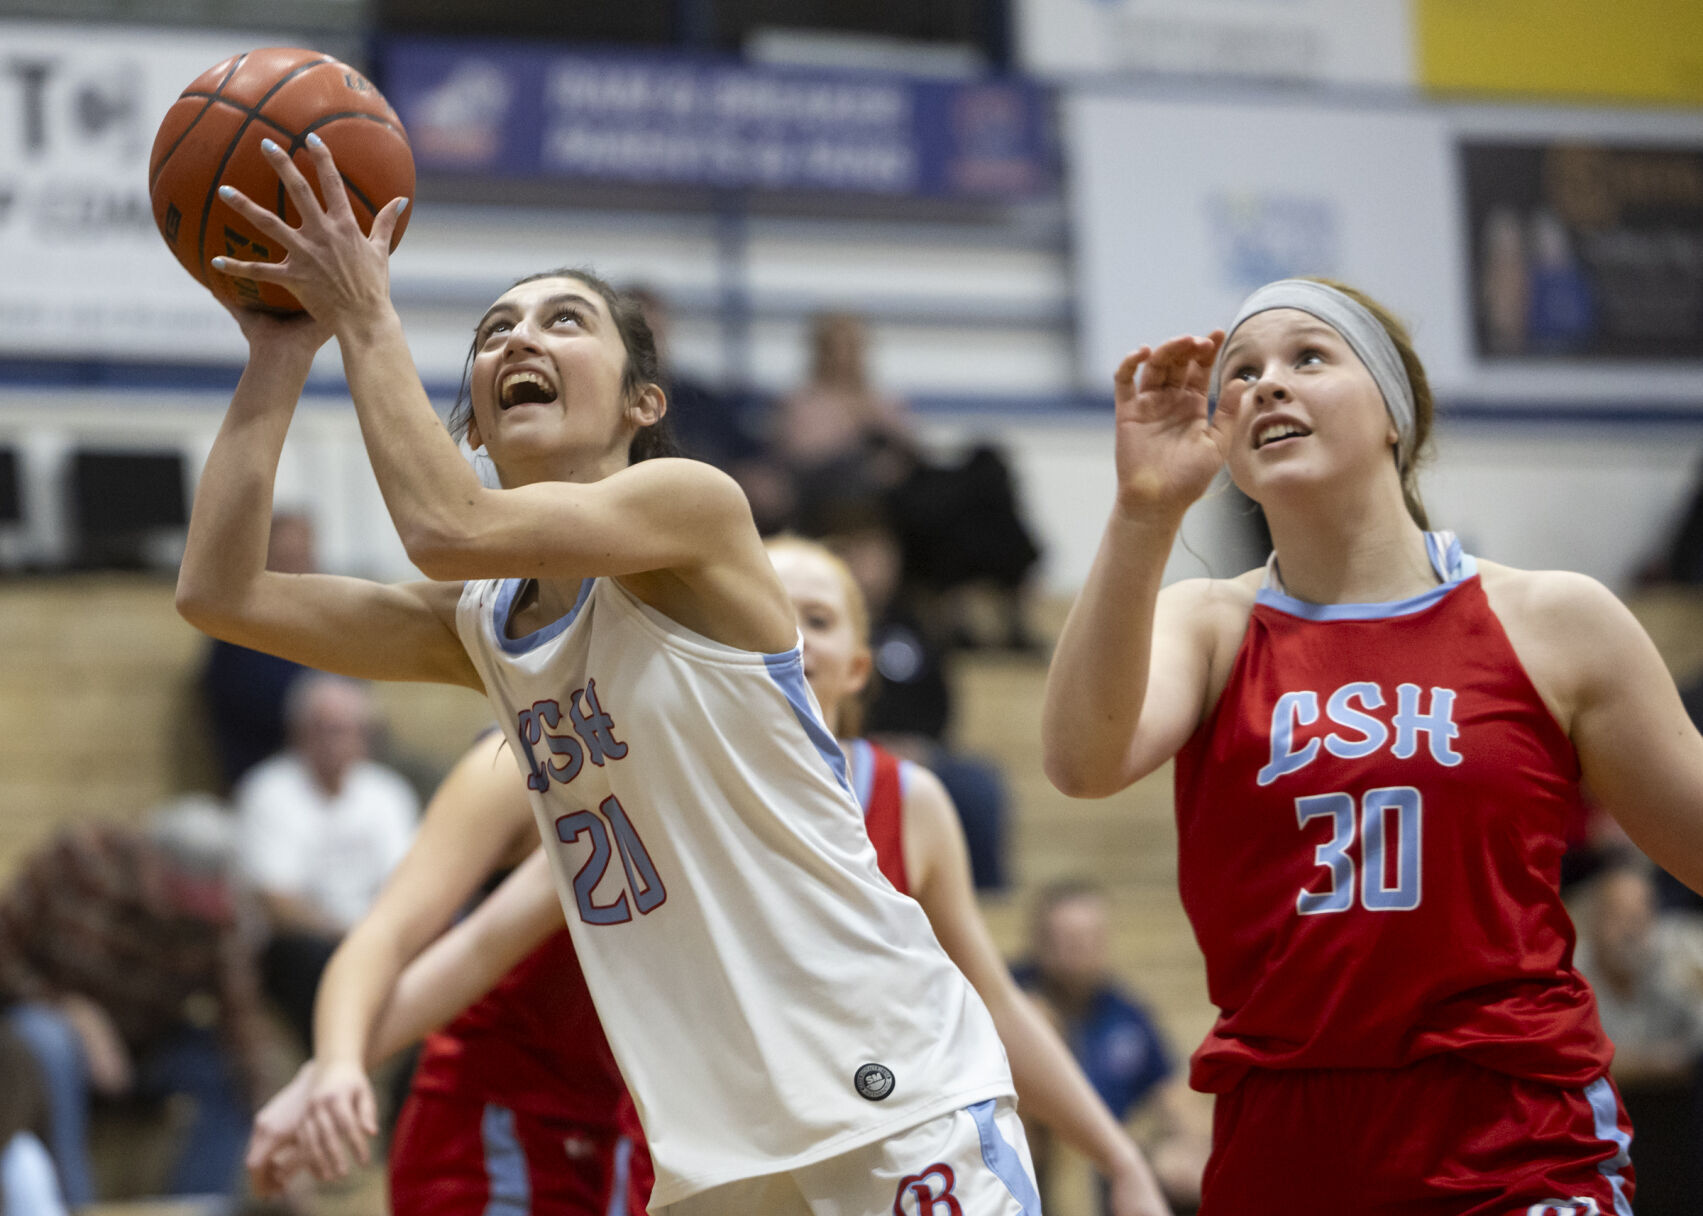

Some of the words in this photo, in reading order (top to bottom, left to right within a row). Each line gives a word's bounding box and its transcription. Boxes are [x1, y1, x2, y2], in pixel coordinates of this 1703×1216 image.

[518, 678, 628, 793] LSH
[1257, 681, 1463, 786] LSH
[555, 793, 667, 926] 20
[1294, 786, 1422, 916] 30
